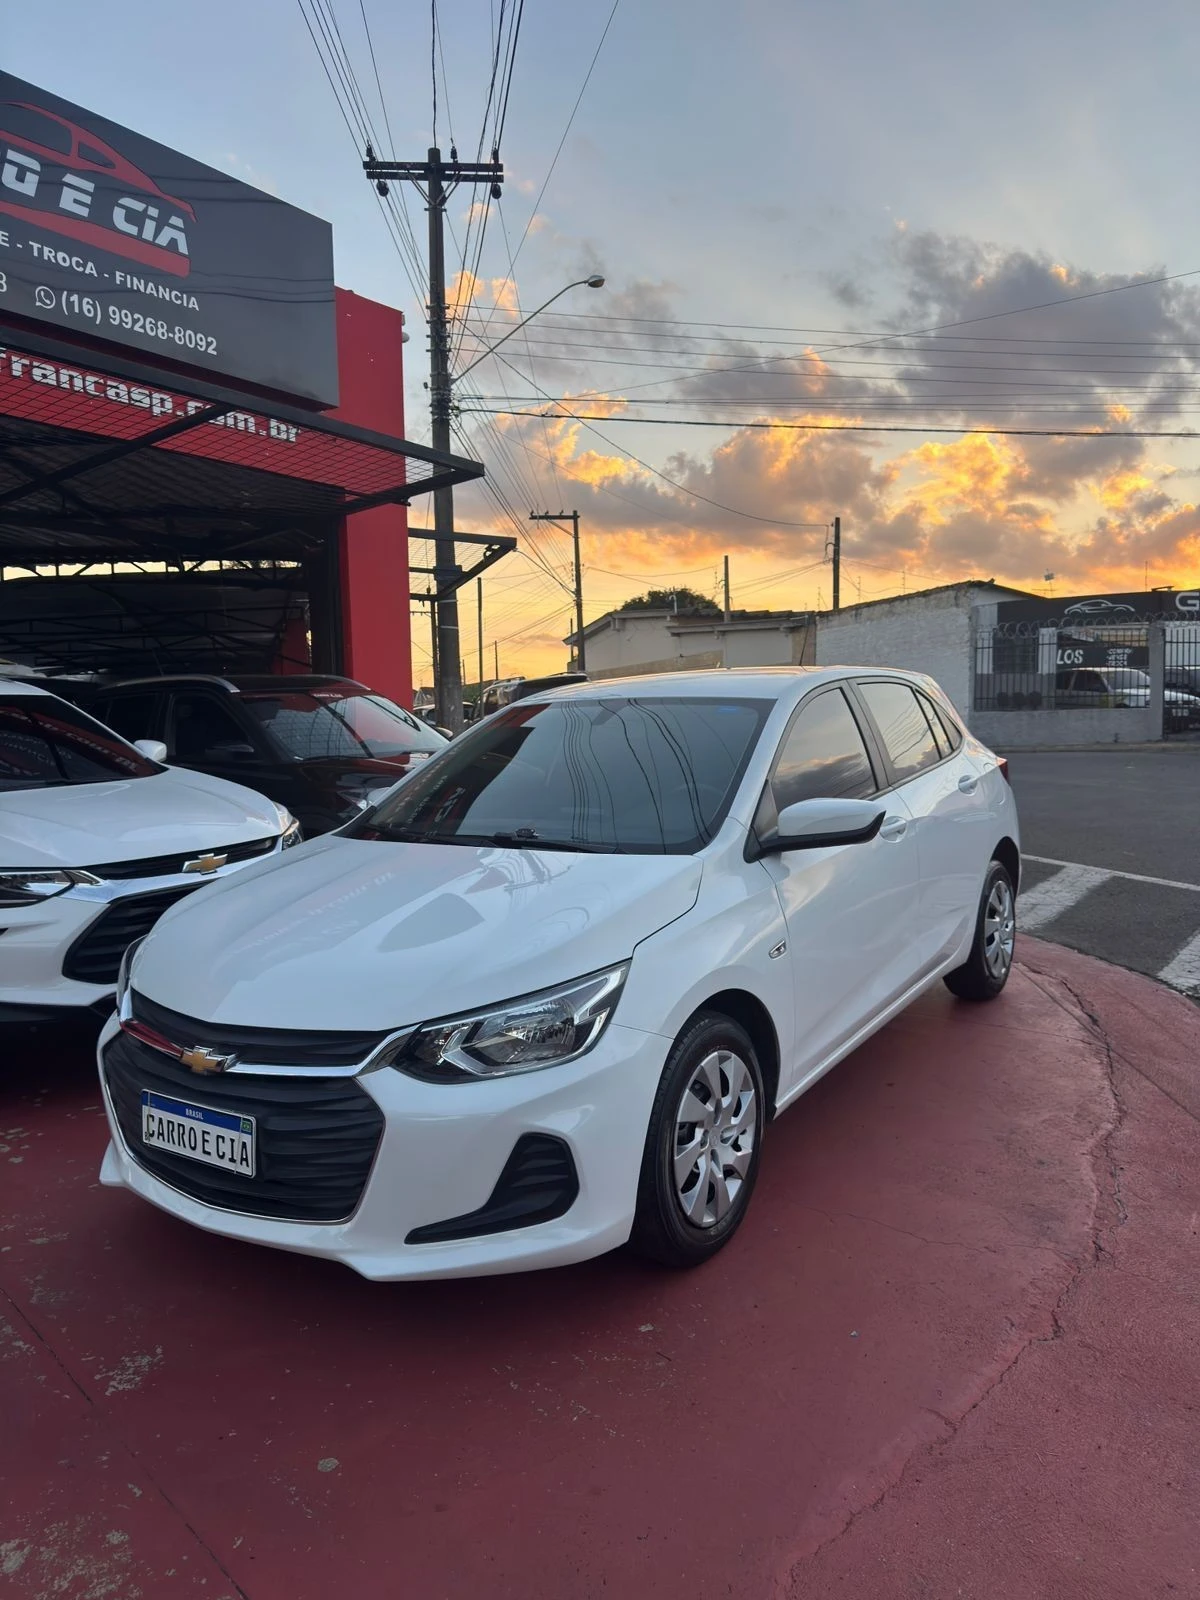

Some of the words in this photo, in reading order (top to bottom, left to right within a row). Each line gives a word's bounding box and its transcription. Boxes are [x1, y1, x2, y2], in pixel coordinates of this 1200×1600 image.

[59, 173, 95, 217] E
[28, 240, 98, 277] TROCA
[115, 270, 200, 312] FINANCIA
[61, 291, 102, 325] (16)
[108, 305, 218, 355] 99268-8092
[146, 1114, 250, 1168] CARROECIA
[185, 1108, 204, 1120] BRASIL
